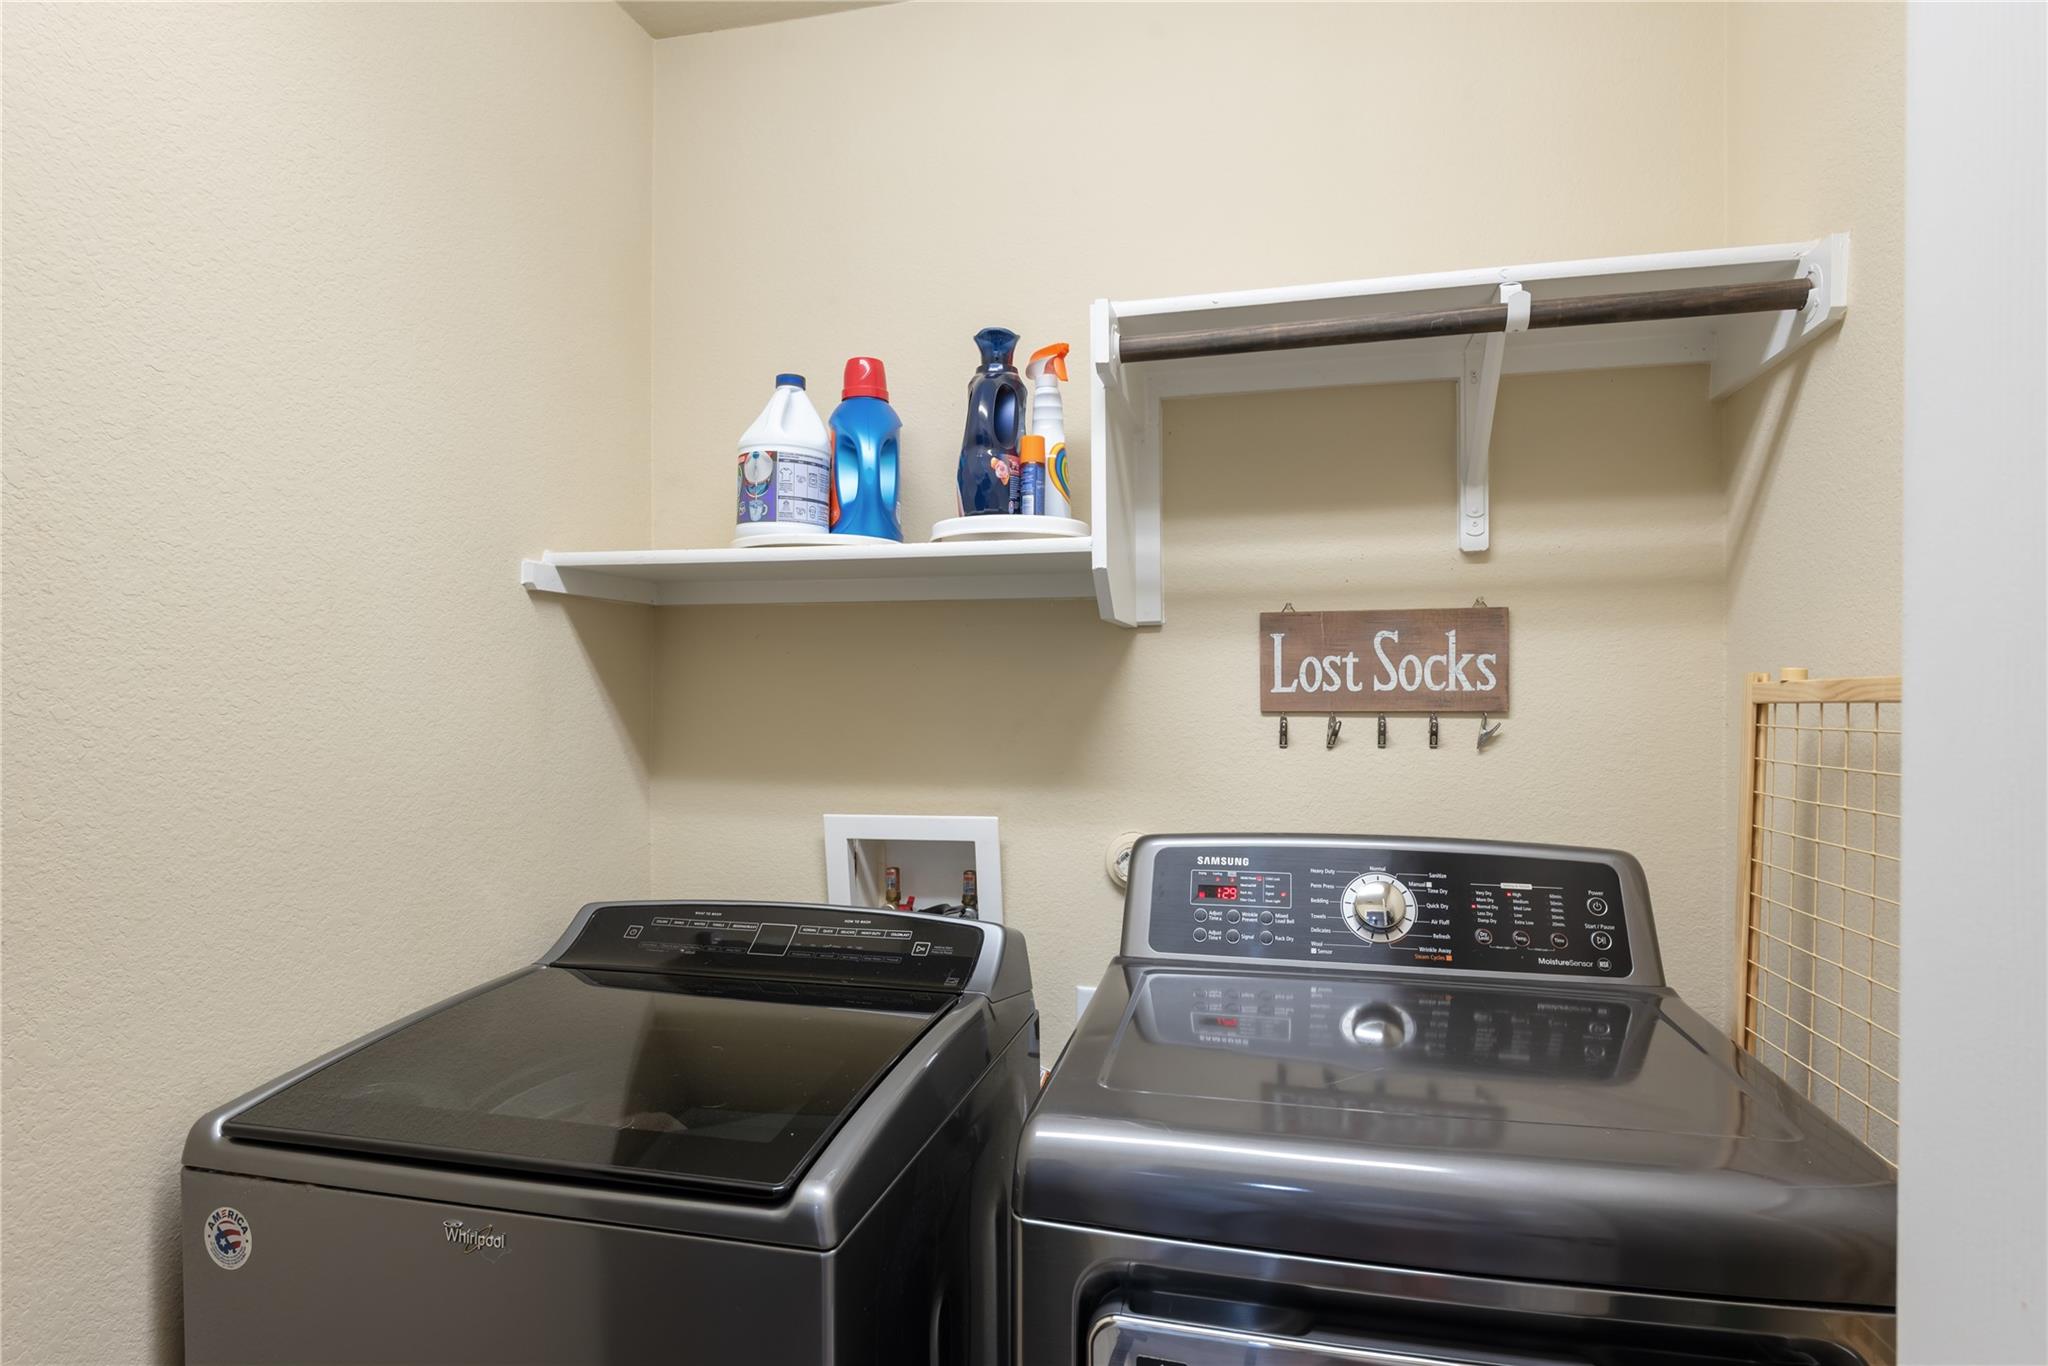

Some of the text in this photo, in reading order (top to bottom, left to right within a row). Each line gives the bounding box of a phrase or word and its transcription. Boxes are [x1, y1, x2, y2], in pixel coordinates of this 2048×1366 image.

[1270, 629, 1497, 693] Lost Socks
[1197, 856, 1249, 866] SAMSUNG
[1538, 958, 1593, 967] MoistureSensor
[208, 1209, 248, 1235] AMERICA
[444, 1224, 506, 1250] Whirlpool
